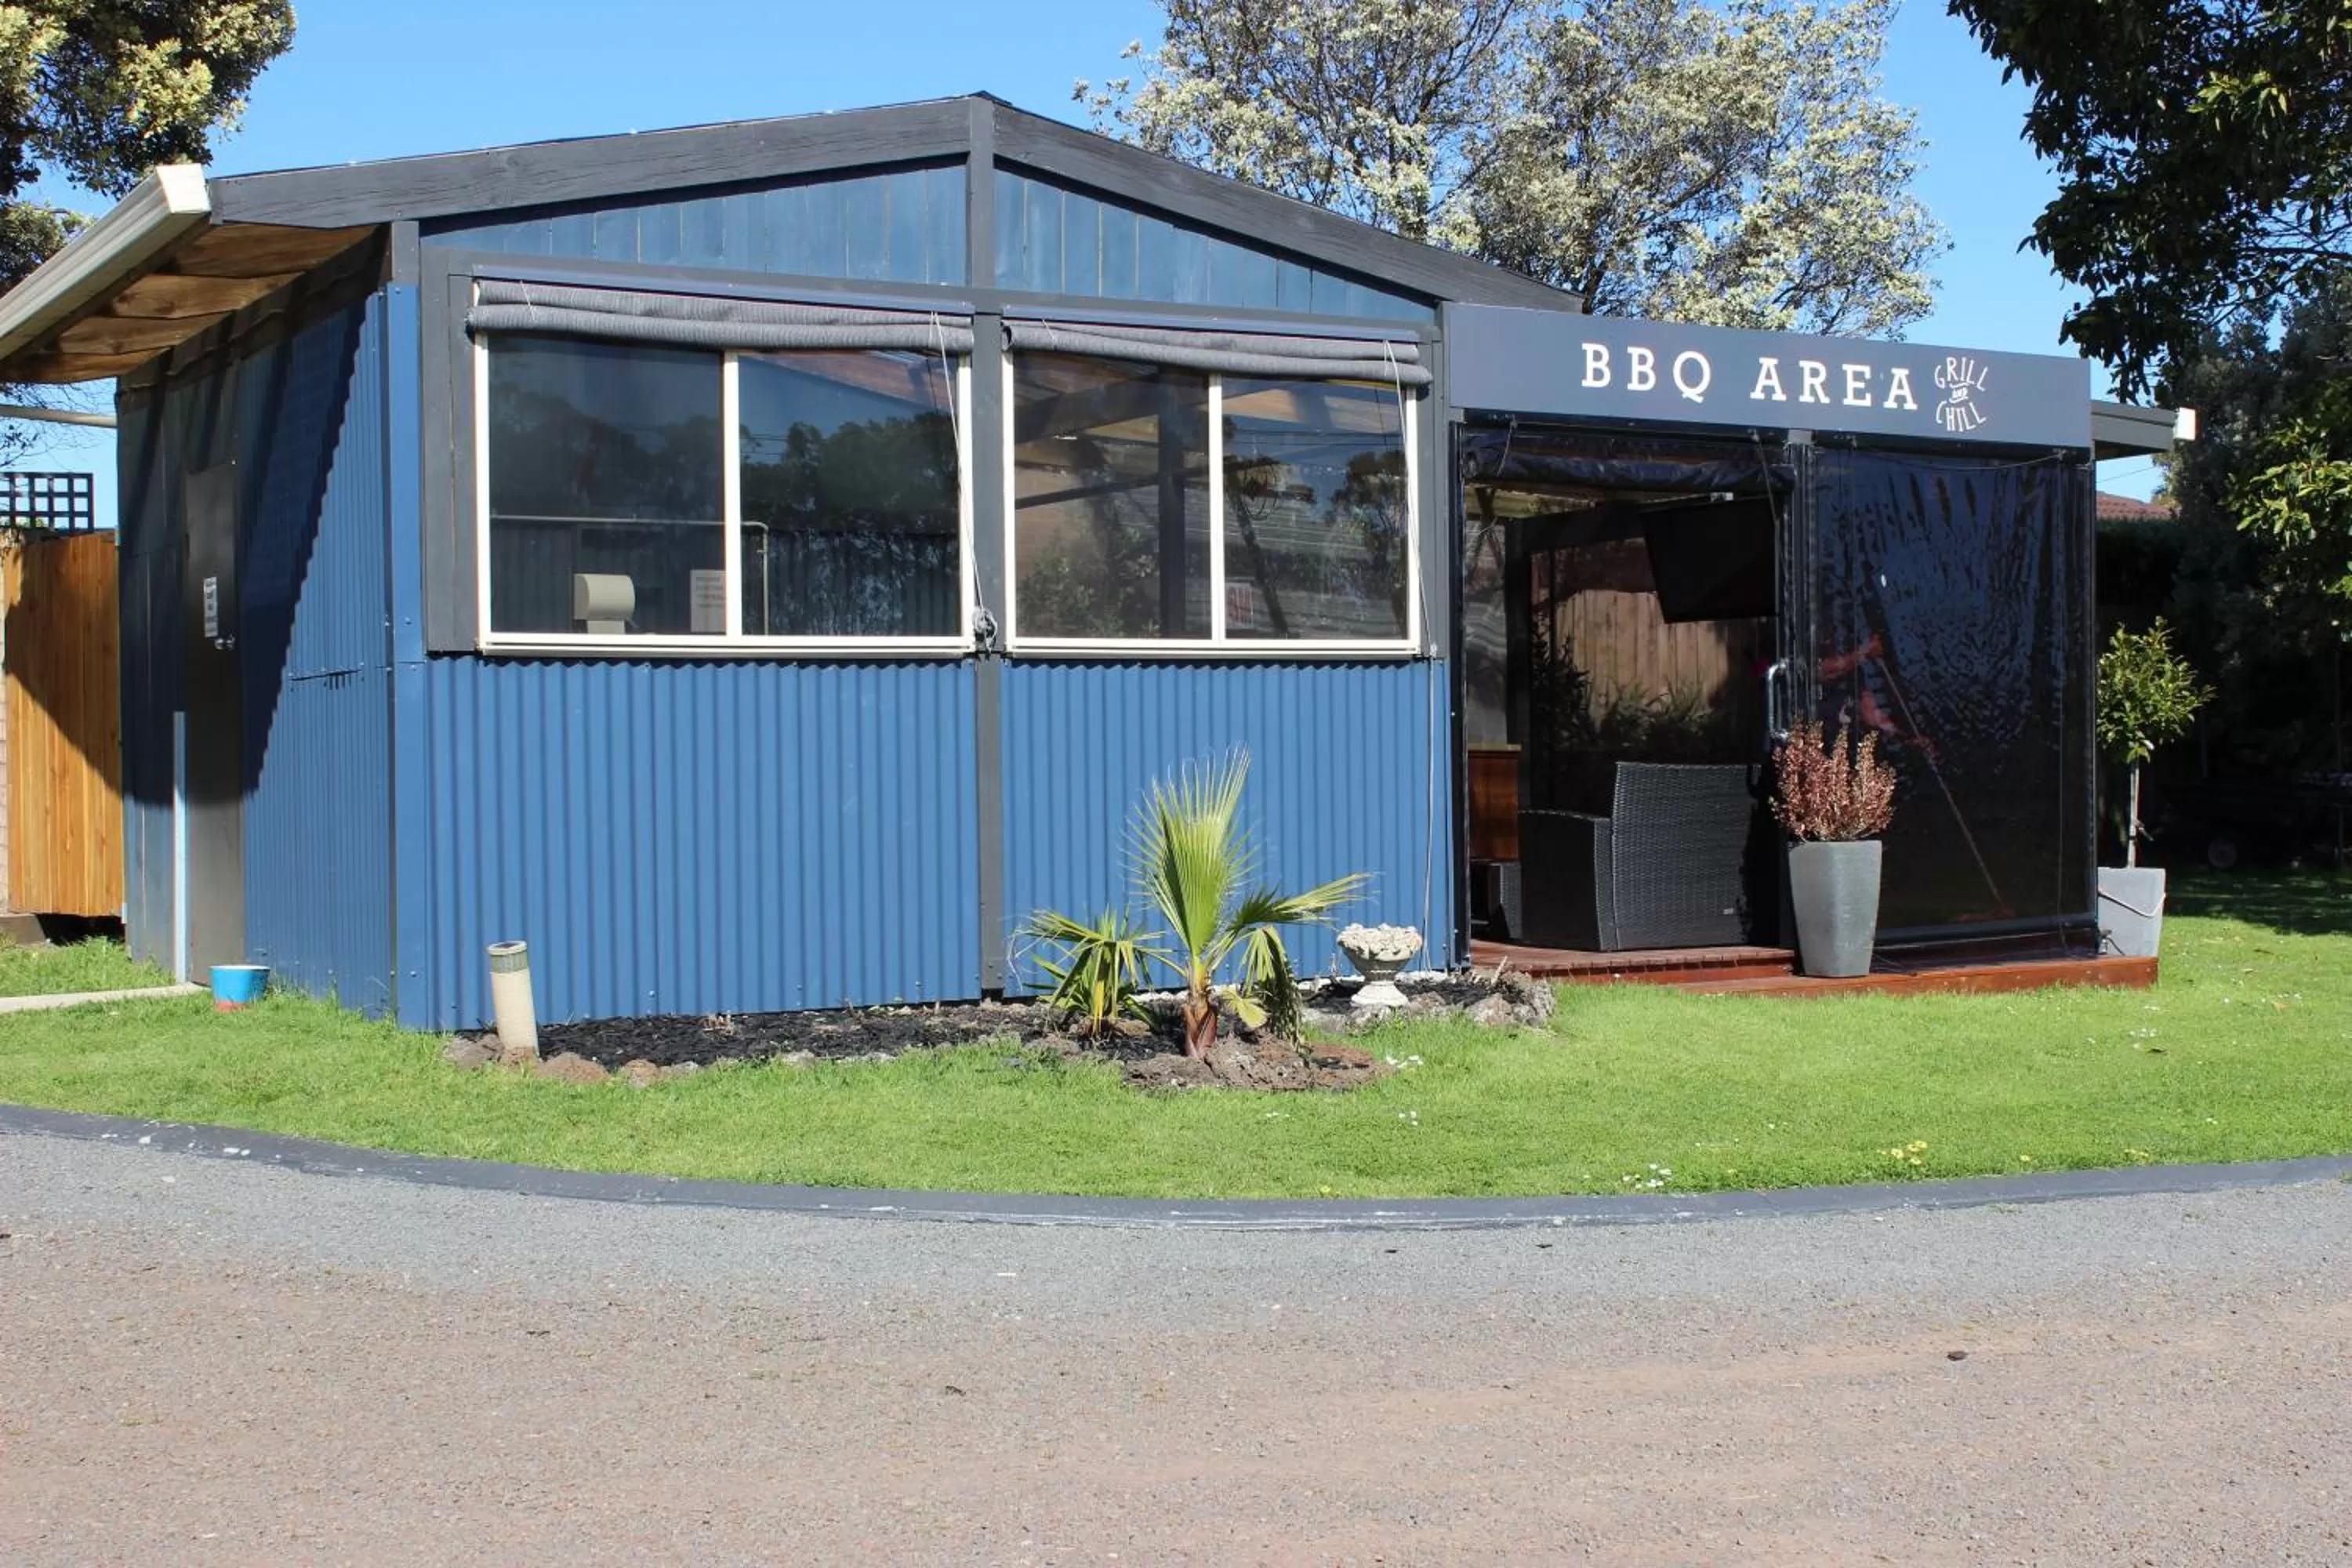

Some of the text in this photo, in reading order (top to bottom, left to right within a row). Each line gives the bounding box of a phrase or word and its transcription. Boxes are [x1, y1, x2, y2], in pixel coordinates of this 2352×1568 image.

[1581, 342, 1918, 411] BBQ AREA
[1934, 356, 1988, 392] GRILL
[1936, 400, 1987, 433] CHILL
